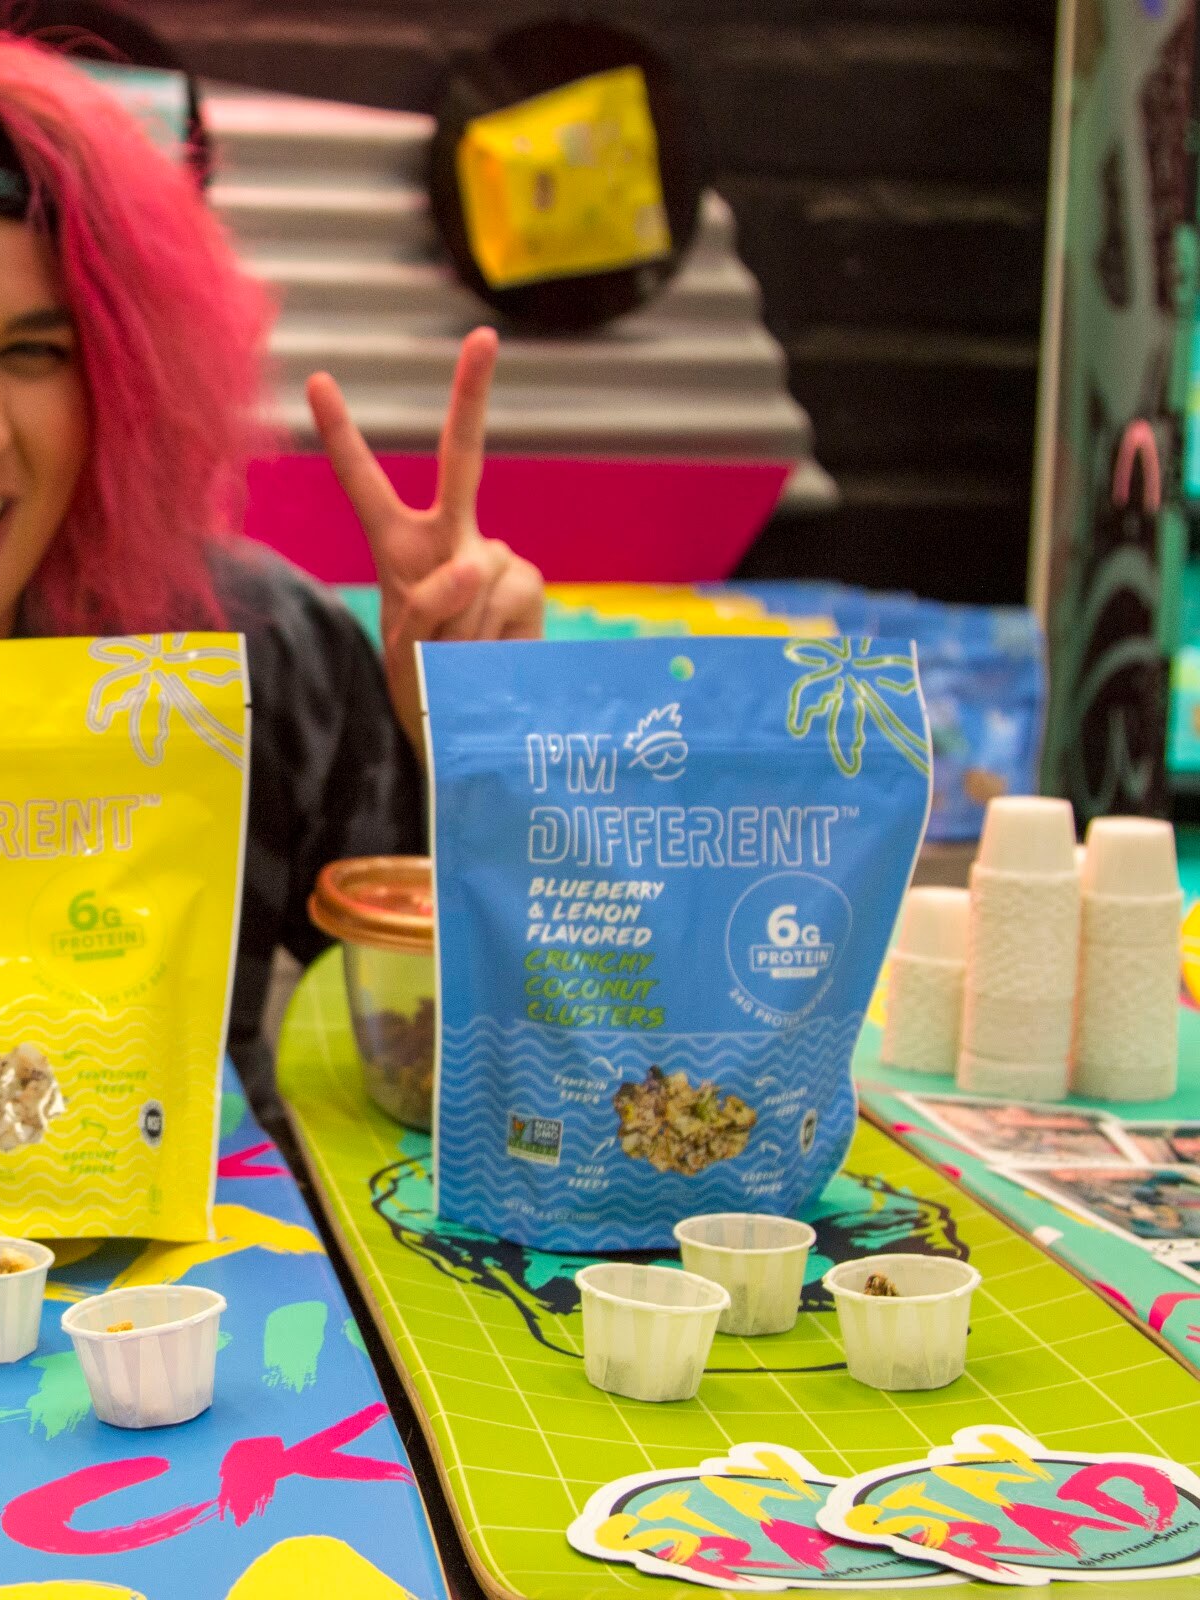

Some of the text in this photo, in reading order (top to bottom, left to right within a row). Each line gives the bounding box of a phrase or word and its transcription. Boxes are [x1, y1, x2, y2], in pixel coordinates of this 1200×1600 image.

[526, 733, 618, 794] I'M
[529, 877, 666, 900] BLUEBERRY
[67, 890, 123, 931] 6G
[528, 901, 642, 923] & LEMON
[527, 923, 653, 948] FLAVORED
[767, 904, 821, 948] 6G
[59, 930, 138, 950] PROTEIN
[523, 948, 656, 974] CRUNCHY
[756, 950, 830, 966] PROTEIN
[523, 975, 661, 1002] COCONUT
[526, 1001, 666, 1029] CLUSTERS
[843, 1432, 1056, 1549] STAY
[594, 1450, 822, 1566] STAY
[907, 1461, 1180, 1576] RAD
